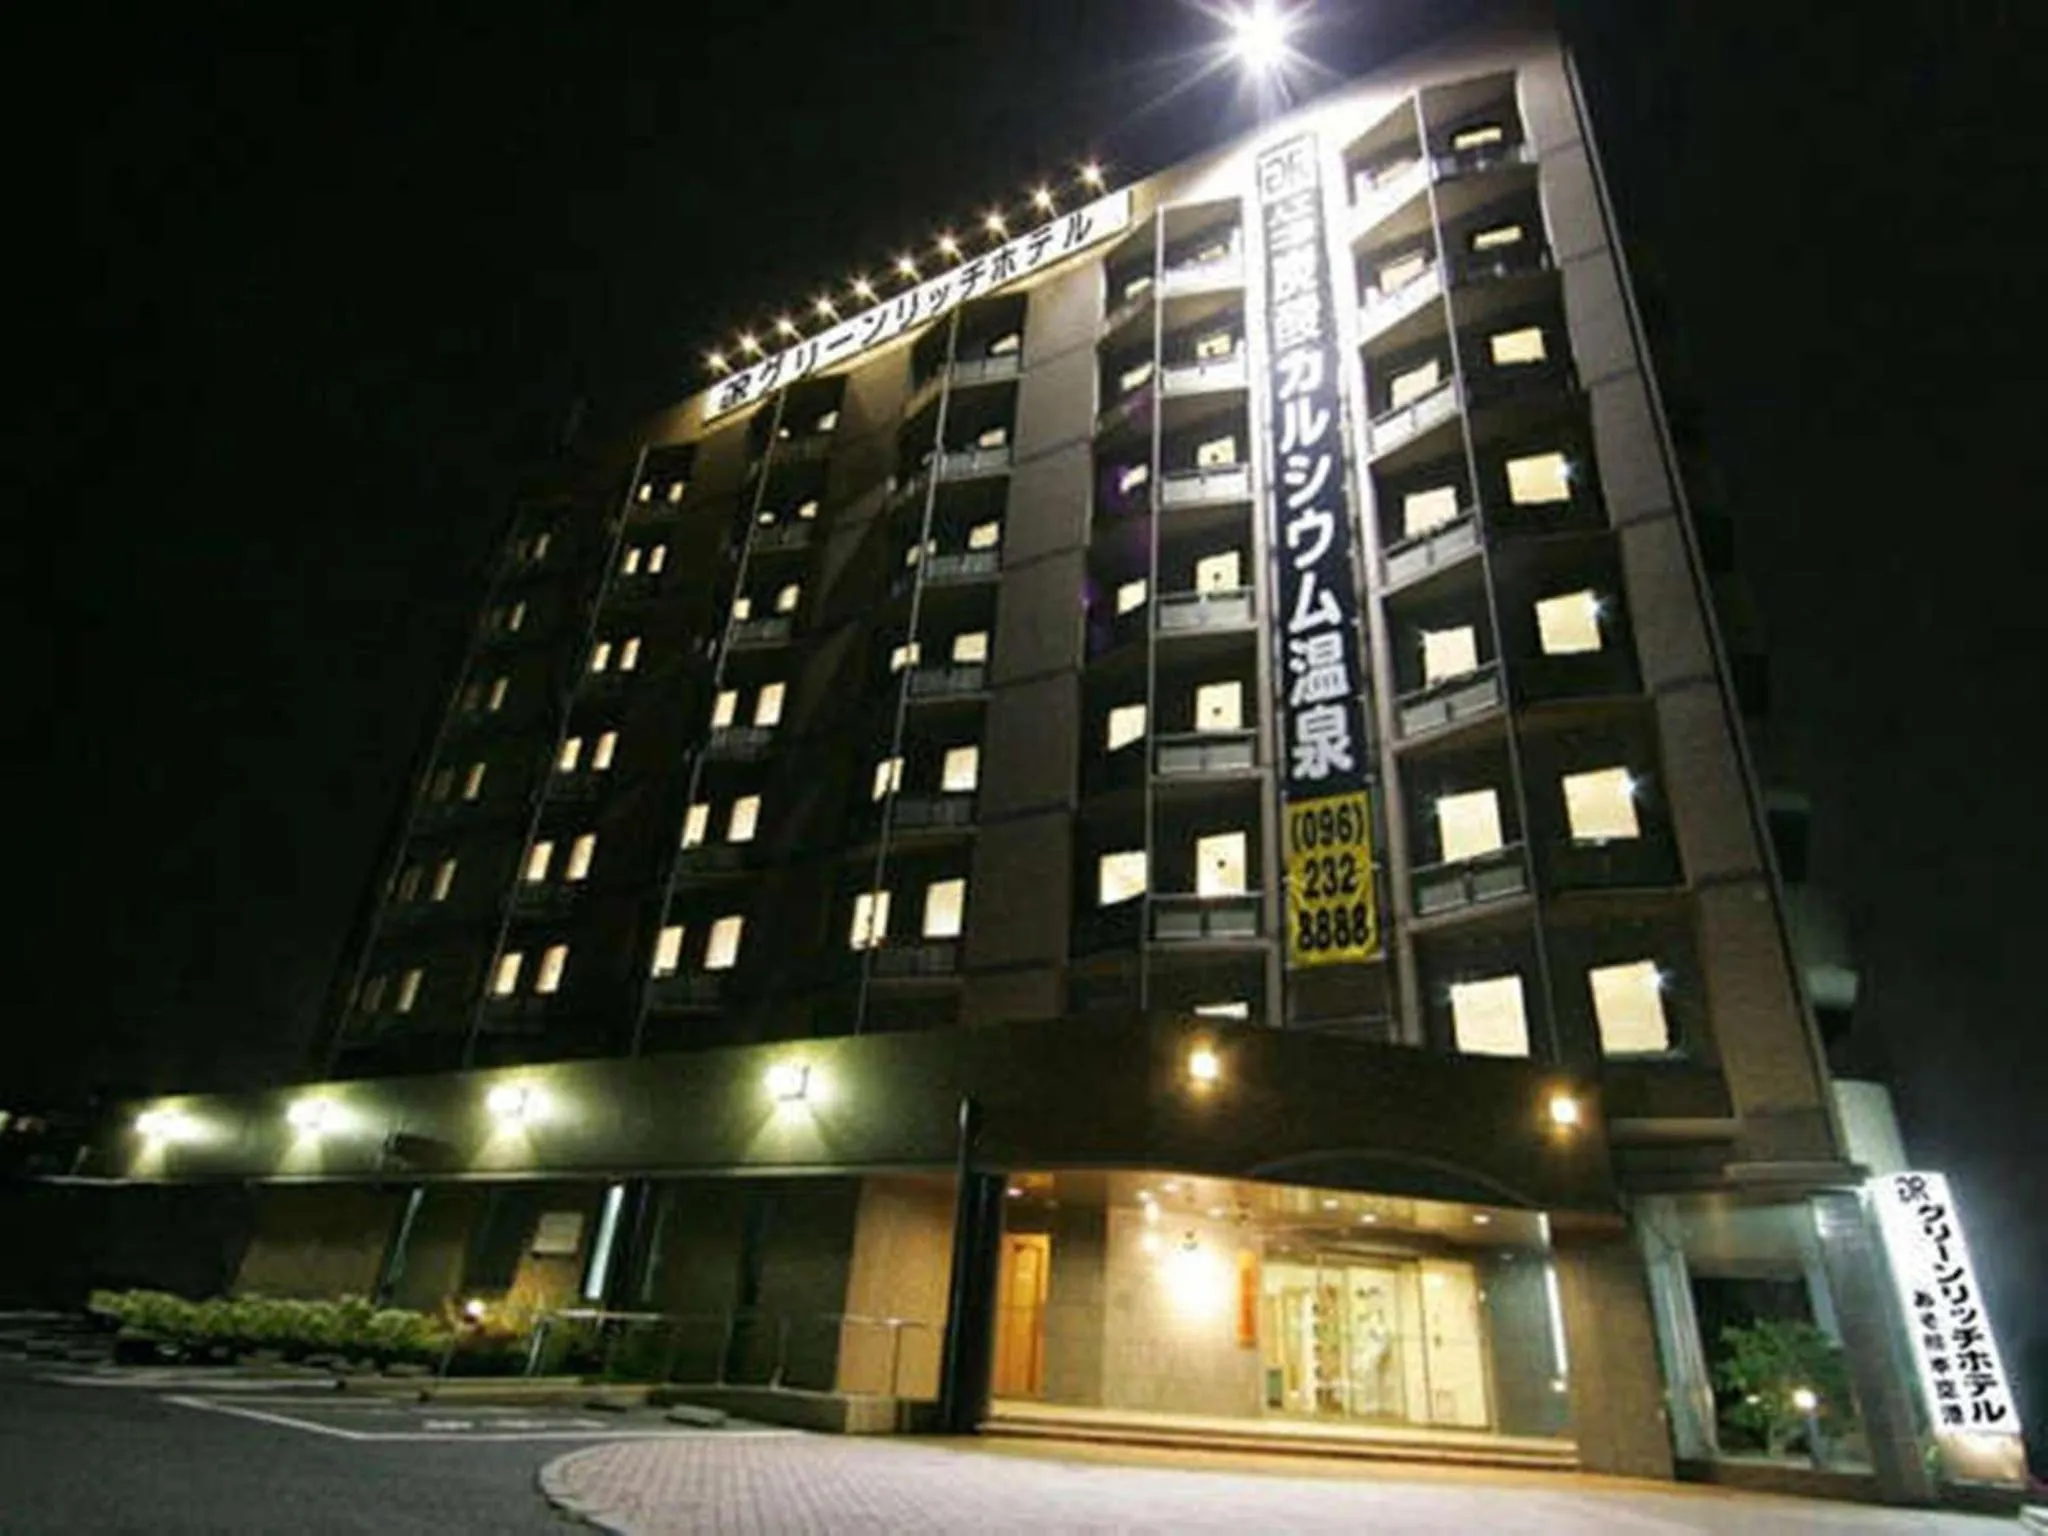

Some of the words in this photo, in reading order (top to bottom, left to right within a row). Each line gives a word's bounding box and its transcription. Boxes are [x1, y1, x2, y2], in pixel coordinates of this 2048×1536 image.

[759, 213, 1094, 390] グリーンリッチホテル
[1291, 801, 1364, 853] (096)
[1304, 853, 1357, 899] 232
[1298, 901, 1369, 952] 8888
[1918, 1203, 2007, 1424] グリーンリッチホテル
